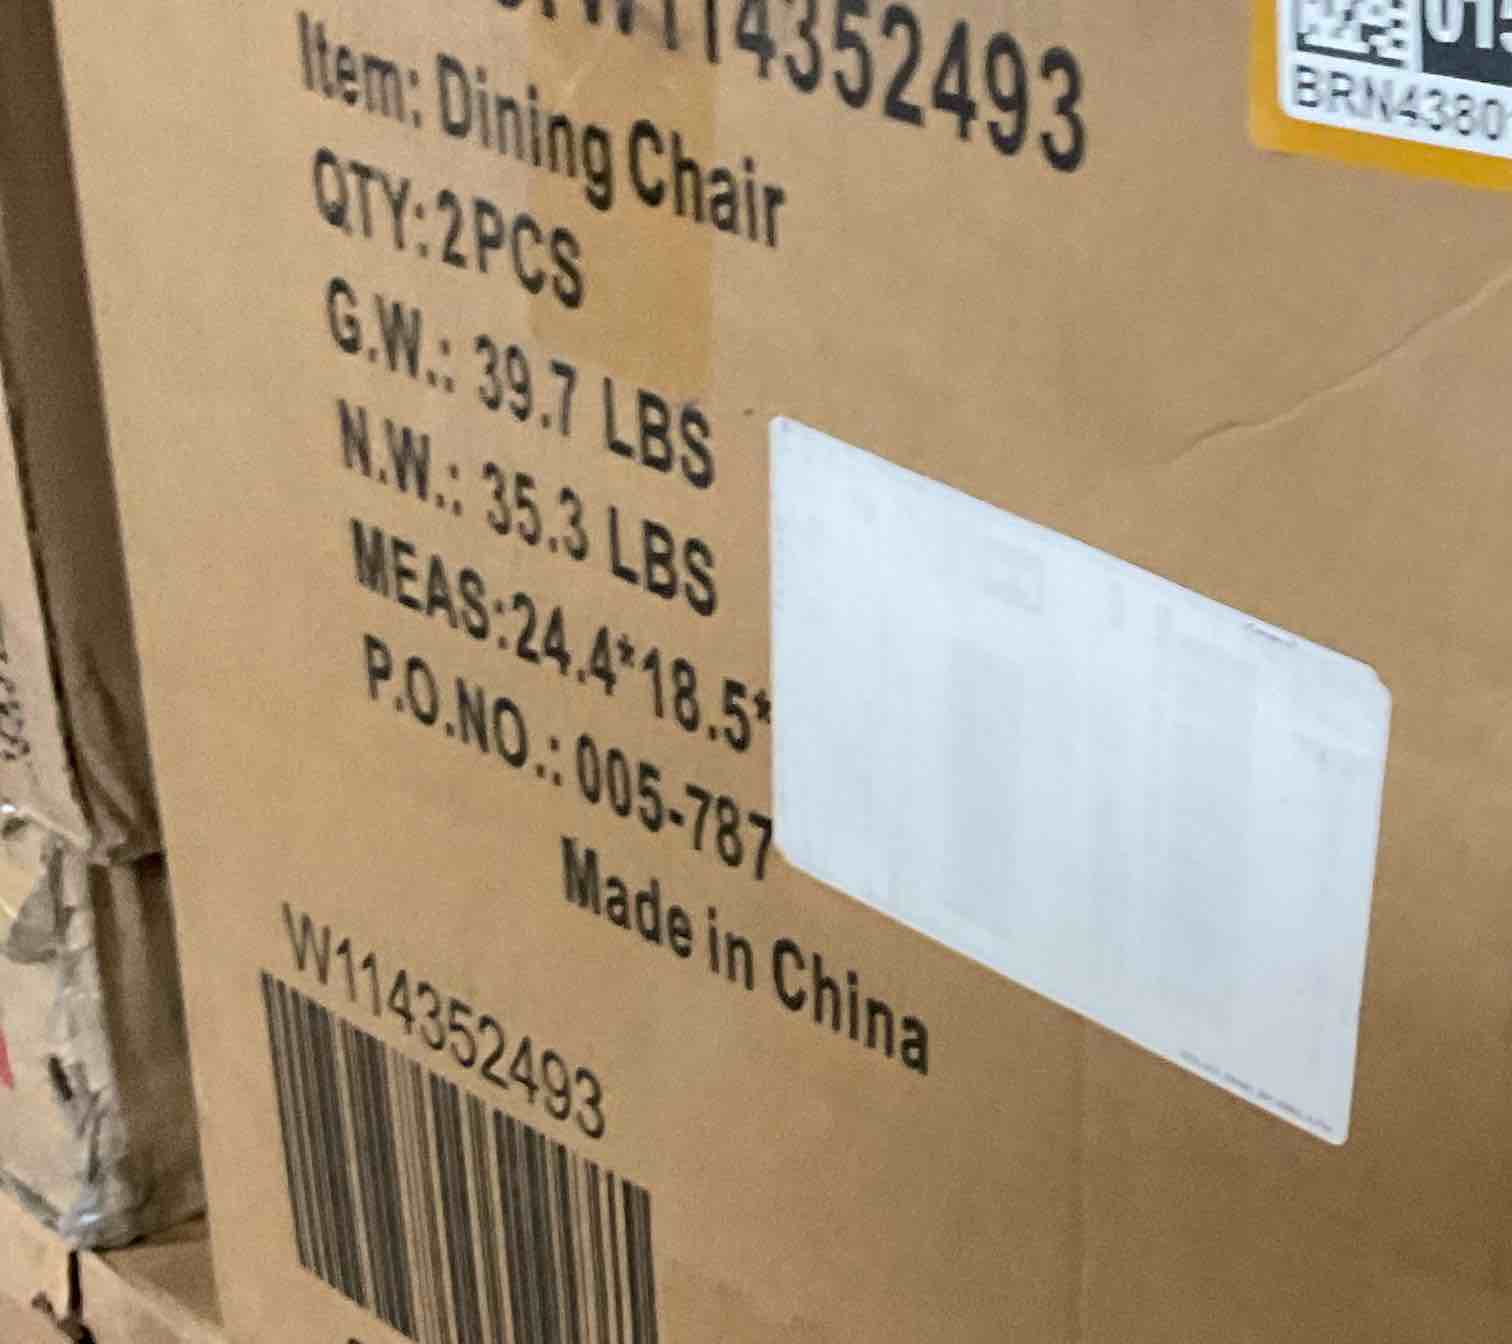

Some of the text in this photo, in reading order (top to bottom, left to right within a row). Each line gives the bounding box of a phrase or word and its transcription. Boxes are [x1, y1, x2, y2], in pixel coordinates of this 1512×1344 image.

[295, 10, 788, 249] Item: Dining Chair
[312, 147, 585, 310] QTY:2PCS
[325, 276, 716, 490] G.W.: 39.7 LBS
[337, 397, 718, 617] N.W.: 35.3 LBS
[362, 632, 774, 881] P.O.NO.: 005-787
[281, 900, 607, 1140] W114352493
[560, 834, 930, 1076] Made in China
